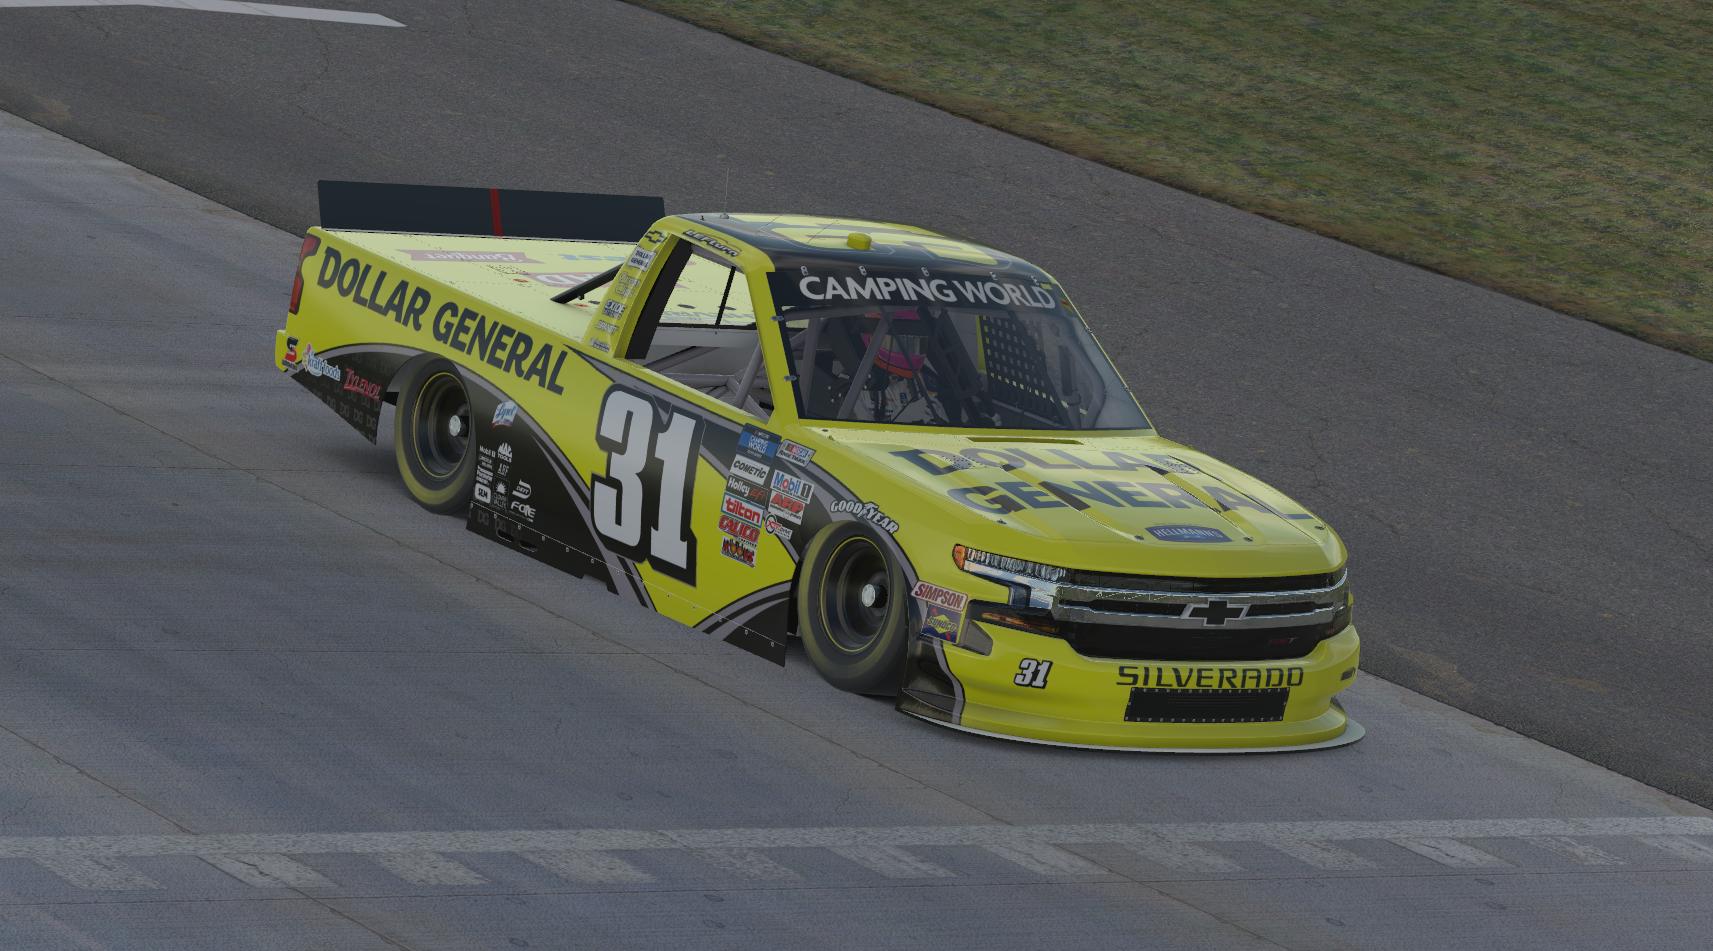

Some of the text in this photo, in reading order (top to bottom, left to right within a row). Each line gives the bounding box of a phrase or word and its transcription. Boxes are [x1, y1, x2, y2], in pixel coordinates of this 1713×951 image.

[630, 257, 649, 268] GENERL
[799, 276, 1056, 309] CAMPING WORLD
[317, 246, 568, 395] DOLLAR GENERAL
[344, 367, 382, 400] TYLENOL
[888, 447, 1200, 476] DOLLAR
[593, 389, 697, 571] 31
[728, 477, 750, 497] Holley
[774, 472, 801, 495] Mobil
[726, 497, 761, 523] tilton
[947, 480, 1314, 520] GENERAL
[915, 584, 964, 609] SIMPSON
[1014, 658, 1053, 688] 31
[1117, 666, 1305, 688] SILVERADO
